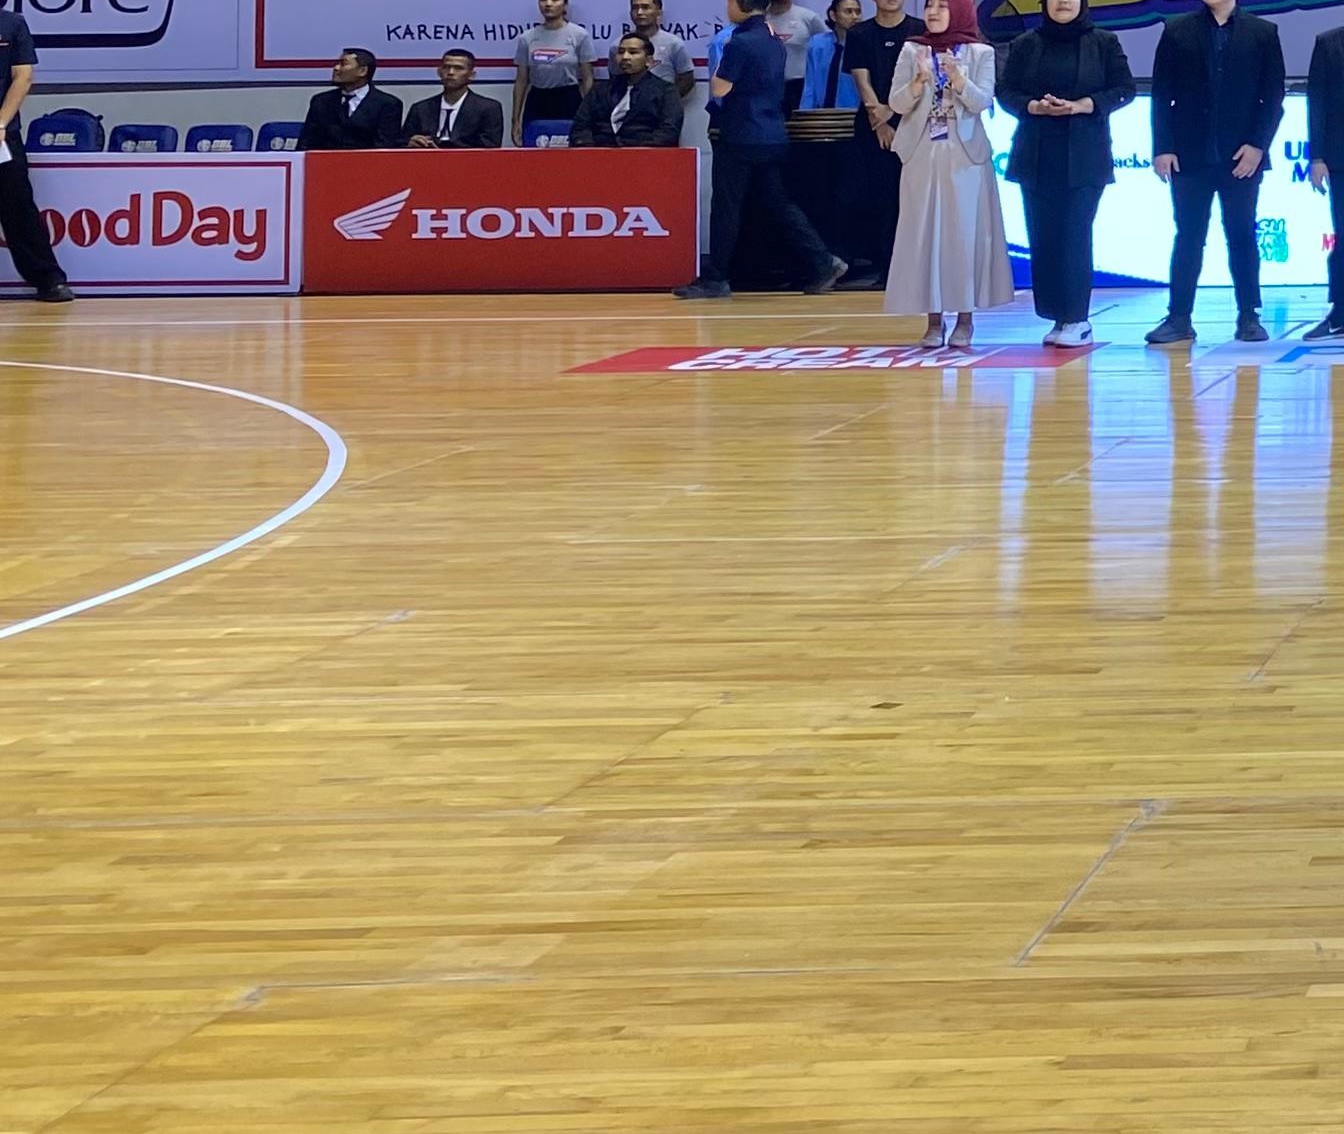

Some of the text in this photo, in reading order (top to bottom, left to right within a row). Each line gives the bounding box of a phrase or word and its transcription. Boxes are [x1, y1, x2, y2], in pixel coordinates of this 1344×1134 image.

[386, 24, 475, 41] KARENA
[2, 191, 267, 261] ood Day
[411, 206, 669, 239] HONDA
